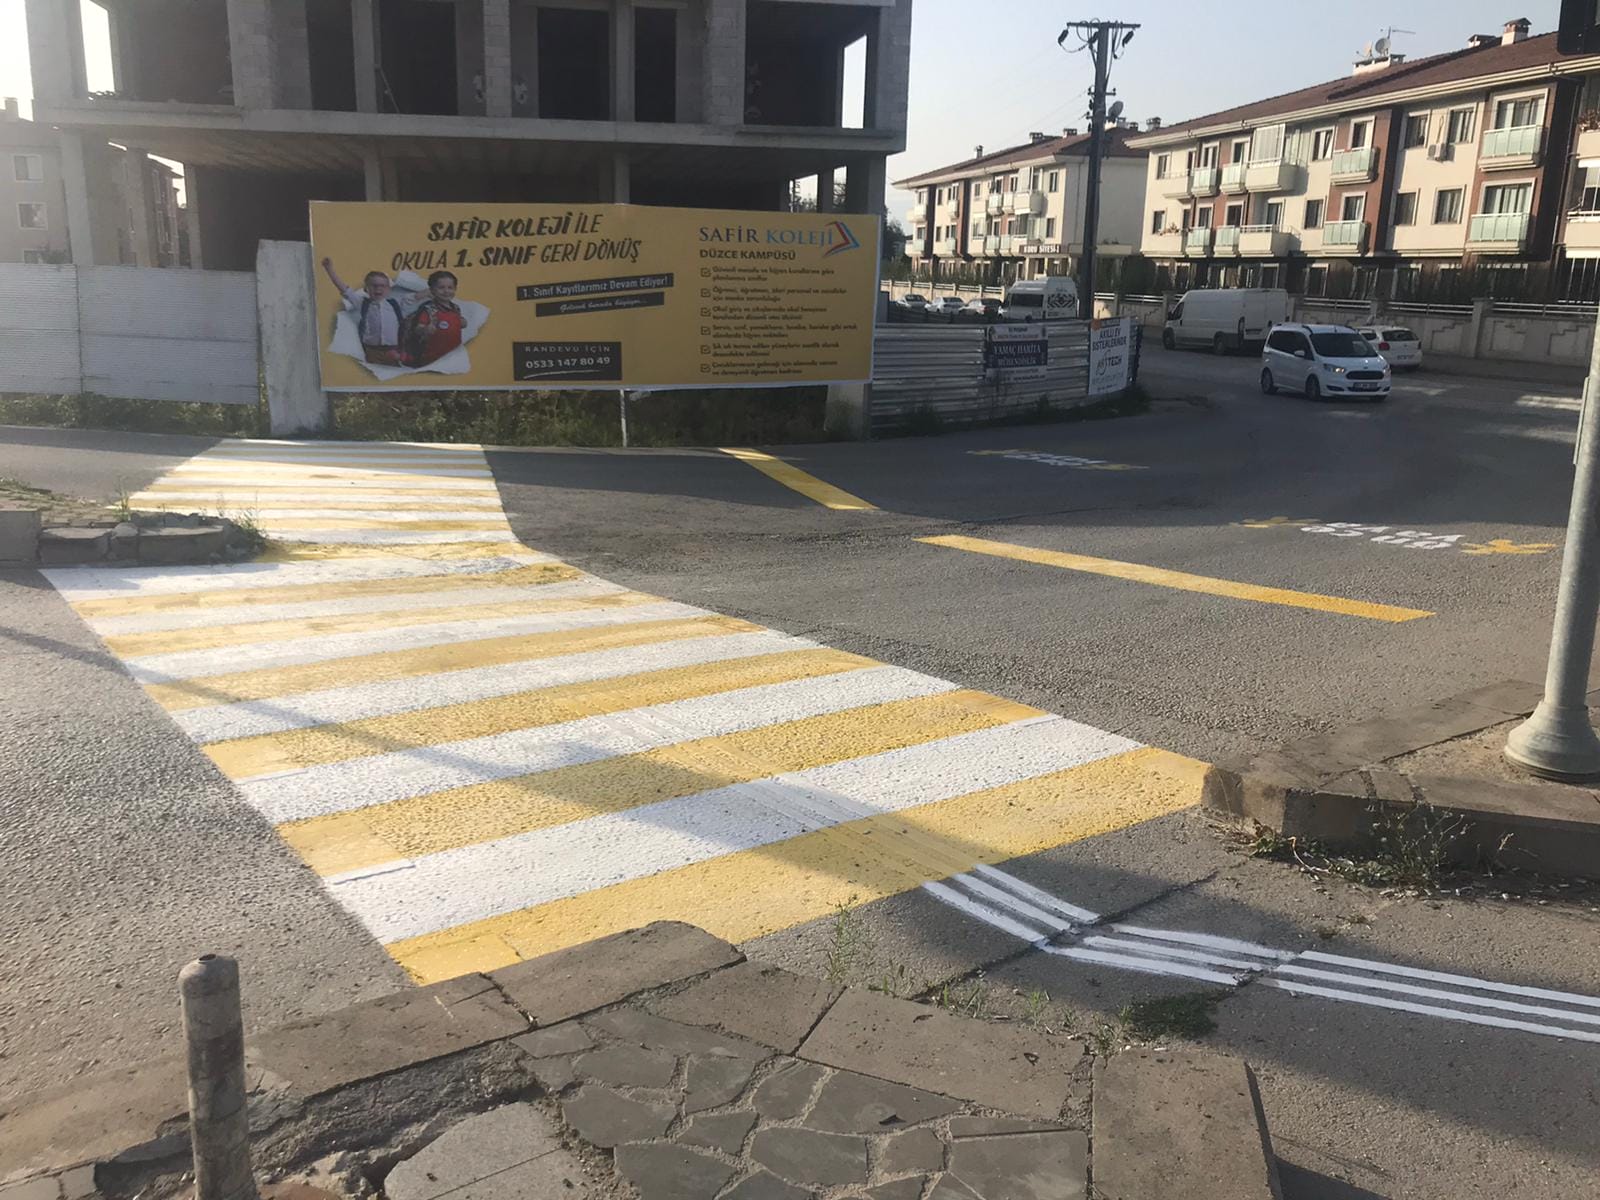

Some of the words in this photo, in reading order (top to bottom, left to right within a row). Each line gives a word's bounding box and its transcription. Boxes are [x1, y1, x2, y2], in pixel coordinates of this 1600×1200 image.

[428, 216, 490, 241] SAFİR
[496, 210, 571, 238] KOLEJİ
[575, 214, 604, 234] İLE
[699, 225, 759, 243] SAFİR
[766, 228, 833, 247] KOLEJİ
[392, 248, 447, 271] OKULA
[453, 248, 473, 267] 1.
[479, 246, 537, 266] SINIF
[540, 240, 581, 263] GERİ
[585, 238, 642, 263] DÖNÜŞ
[700, 248, 738, 259] DÜZCE
[740, 250, 796, 261] KAMPÜSÜ
[610, 279, 638, 291] Devam
[640, 275, 668, 289] Ediyor!
[585, 344, 611, 354] İÇİN
[526, 359, 555, 370] 0533
[558, 358, 577, 368] 147
[580, 357, 595, 367] 80
[597, 356, 611, 366] 49
